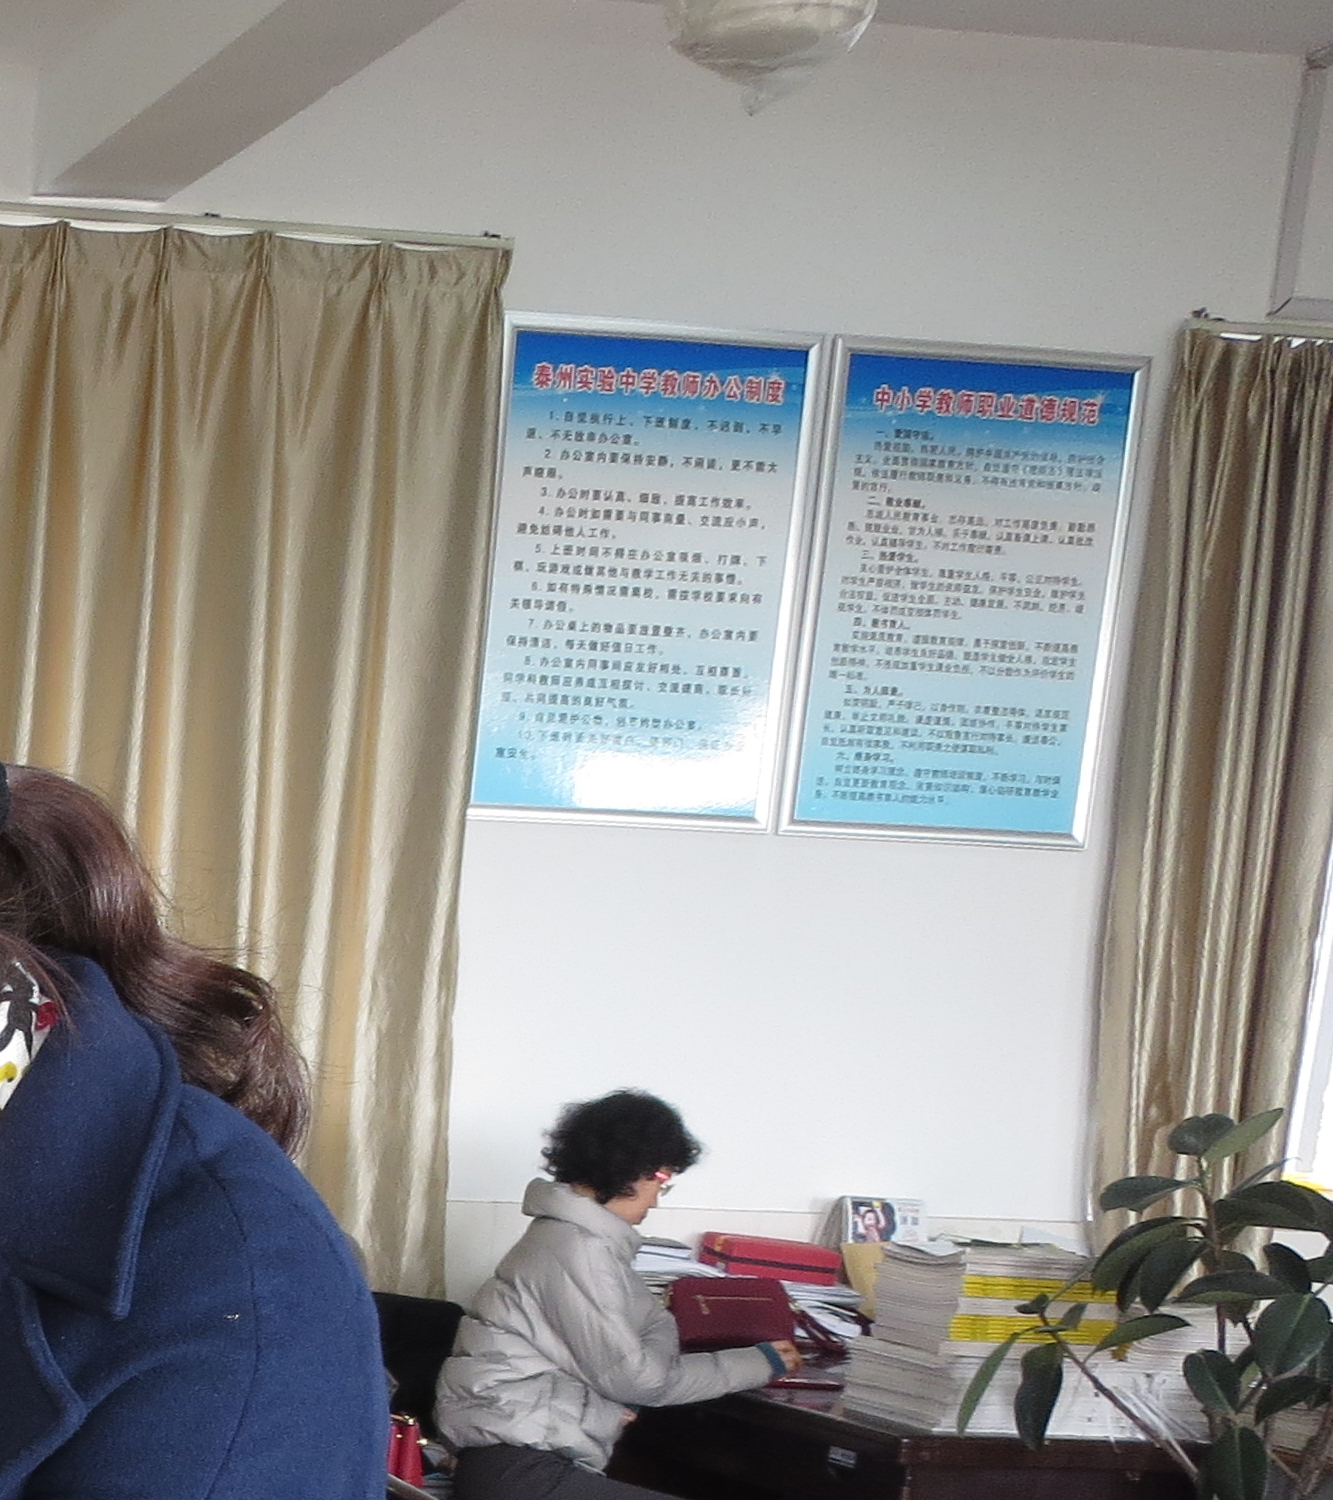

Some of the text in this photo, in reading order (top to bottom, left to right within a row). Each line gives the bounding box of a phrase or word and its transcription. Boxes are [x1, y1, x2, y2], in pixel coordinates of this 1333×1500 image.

[532, 363, 786, 403] 泰州实验中学教师办公制度
[874, 385, 1100, 424] 中小学教师职业道德规范
